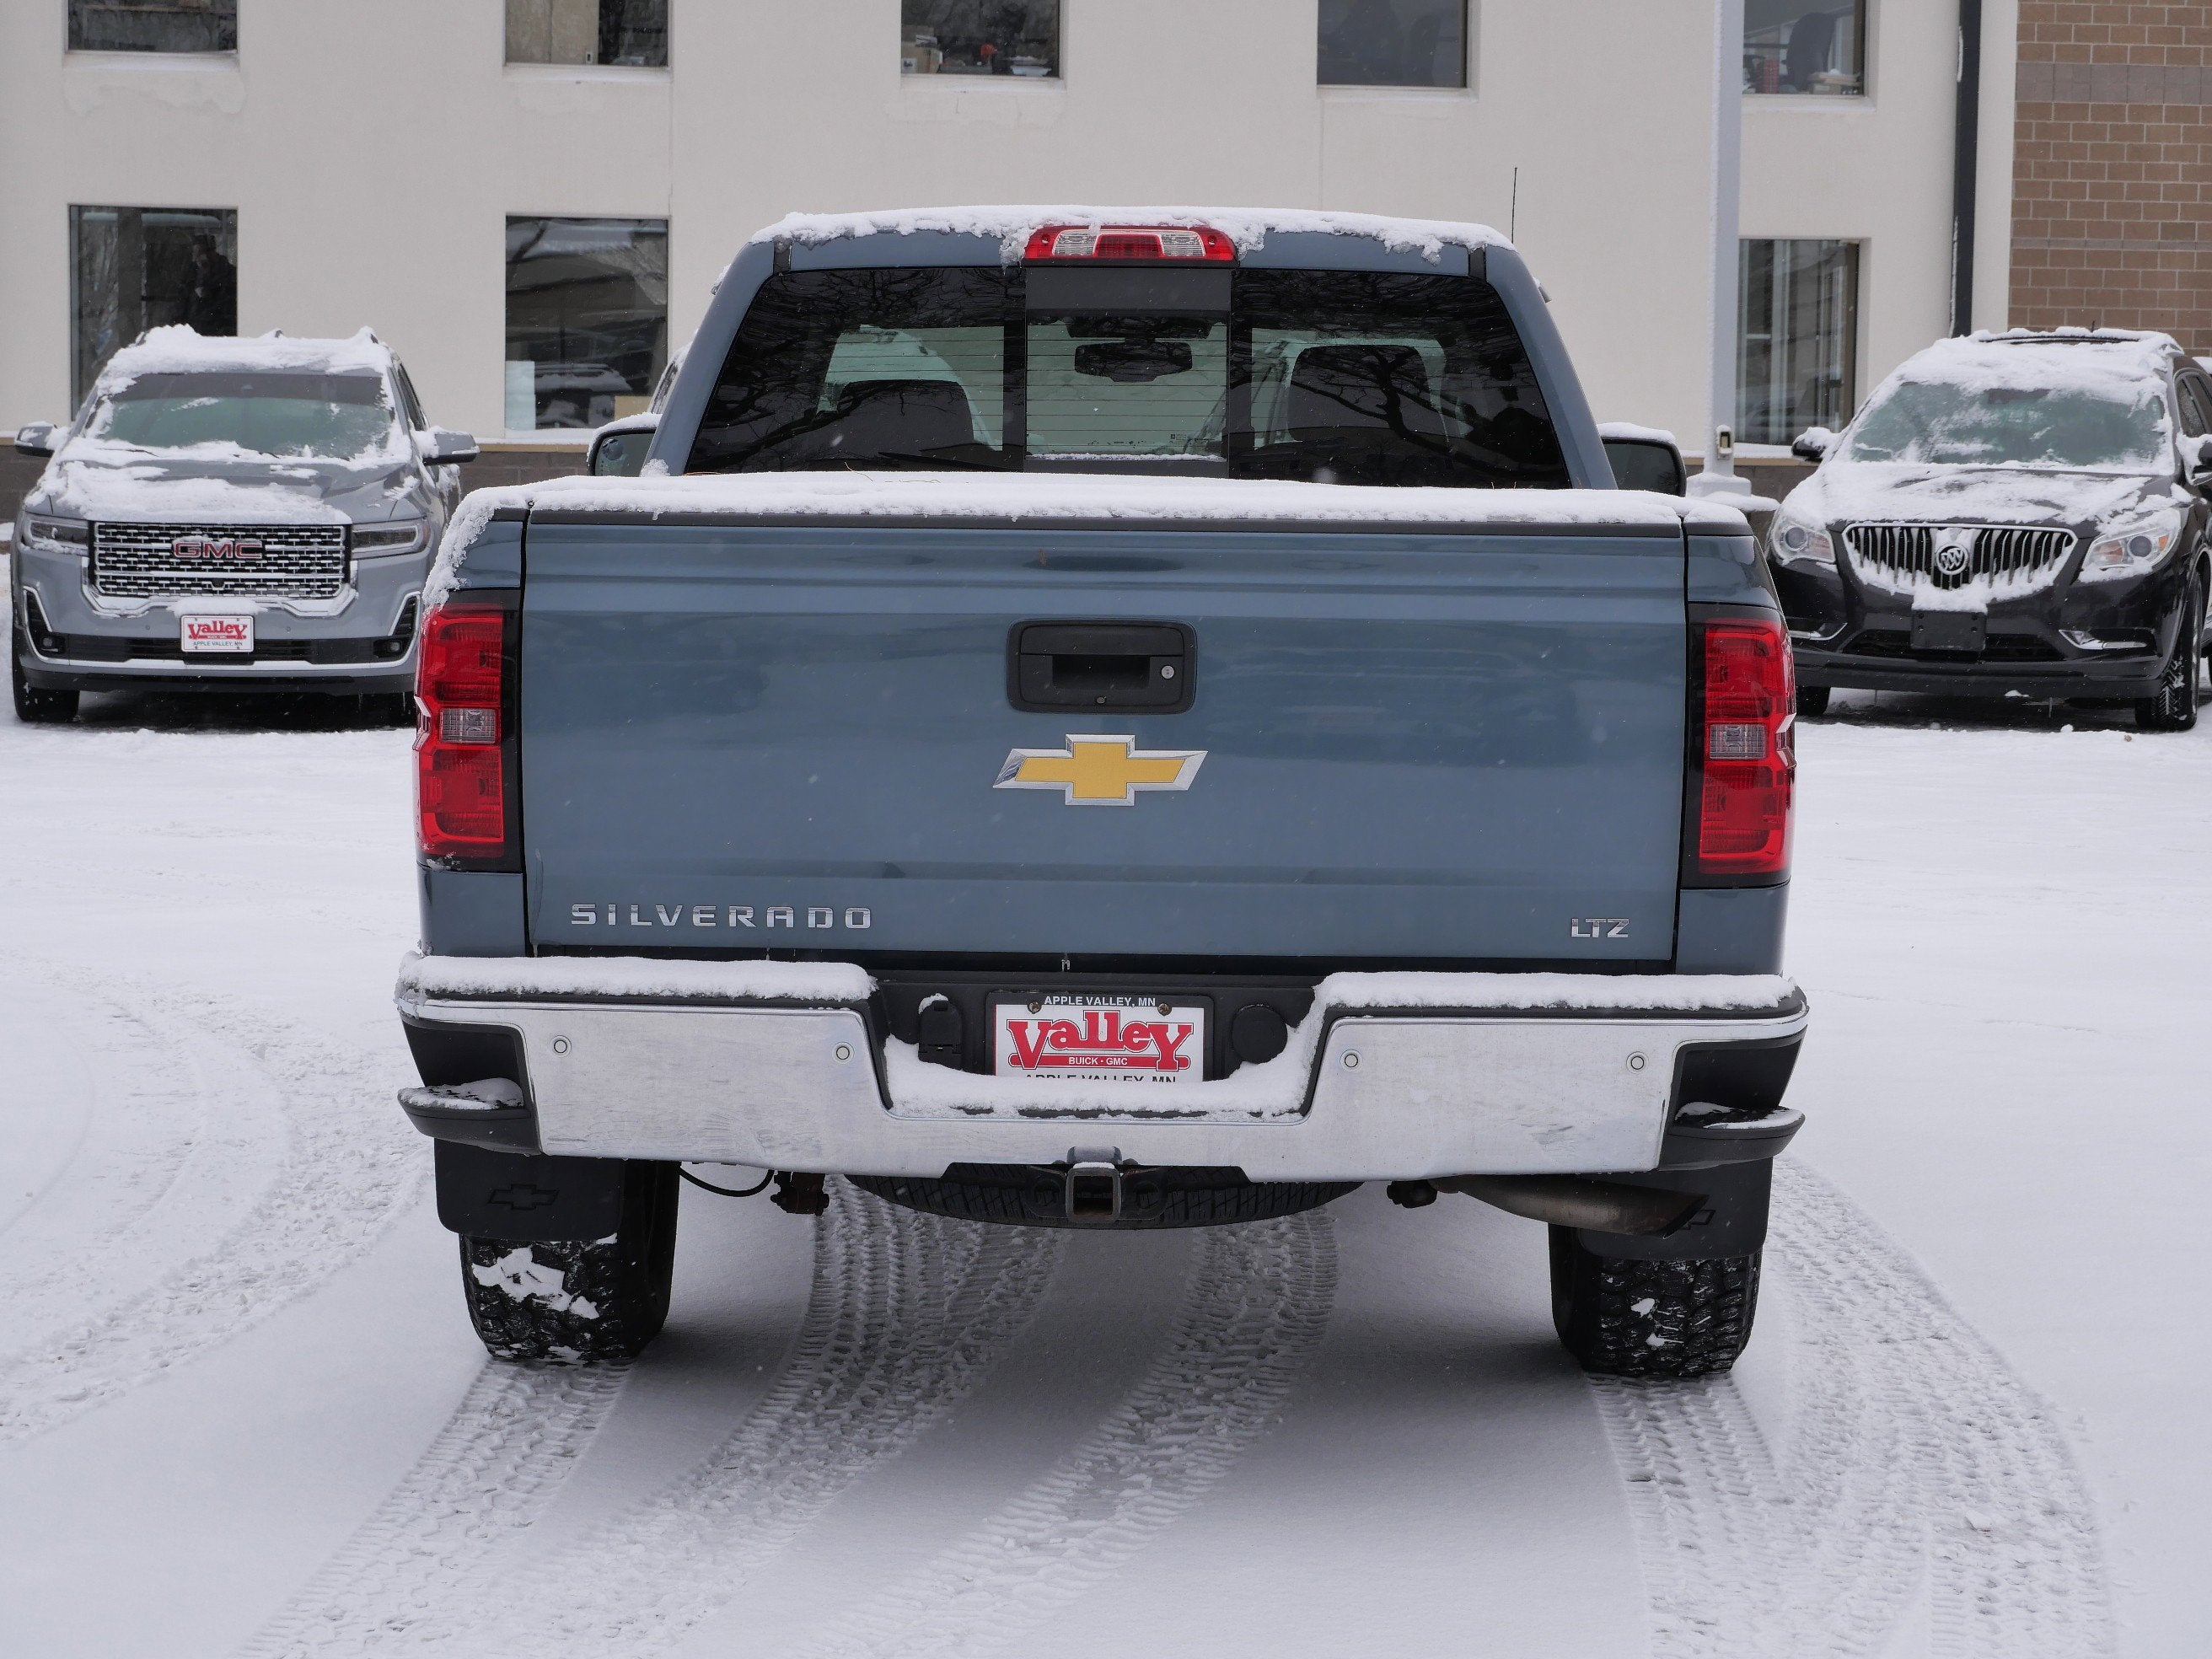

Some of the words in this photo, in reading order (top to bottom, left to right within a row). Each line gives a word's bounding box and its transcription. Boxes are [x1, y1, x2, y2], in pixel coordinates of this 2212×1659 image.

[174, 541, 263, 559] GMC
[571, 904, 872, 929] SILVERADO
[1570, 918, 1629, 938] LTZ
[1044, 996, 1083, 1006] APPLE
[1086, 996, 1136, 1008] VALLEY,
[1138, 997, 1156, 1007] MN
[1068, 1056, 1098, 1066] BUICK
[1106, 1057, 1128, 1066] GMC
